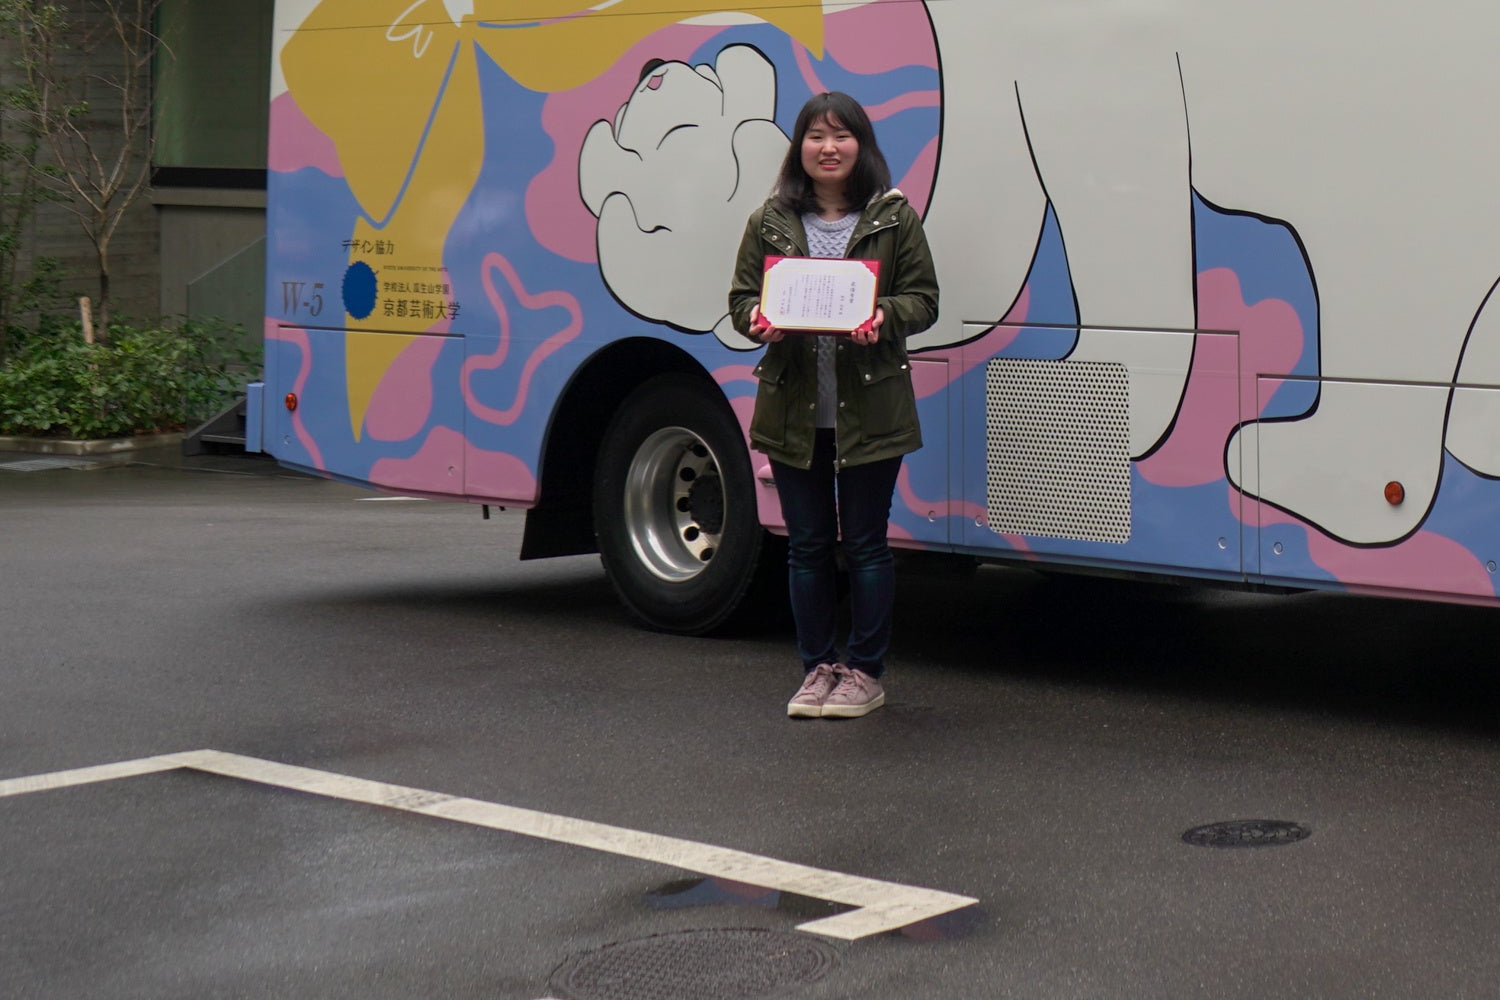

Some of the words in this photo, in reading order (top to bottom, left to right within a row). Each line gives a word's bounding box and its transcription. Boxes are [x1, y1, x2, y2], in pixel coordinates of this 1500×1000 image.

[342, 239, 394, 255] デザイン協力
[282, 281, 325, 317] W-5
[383, 298, 461, 320] 京都芸術大学
